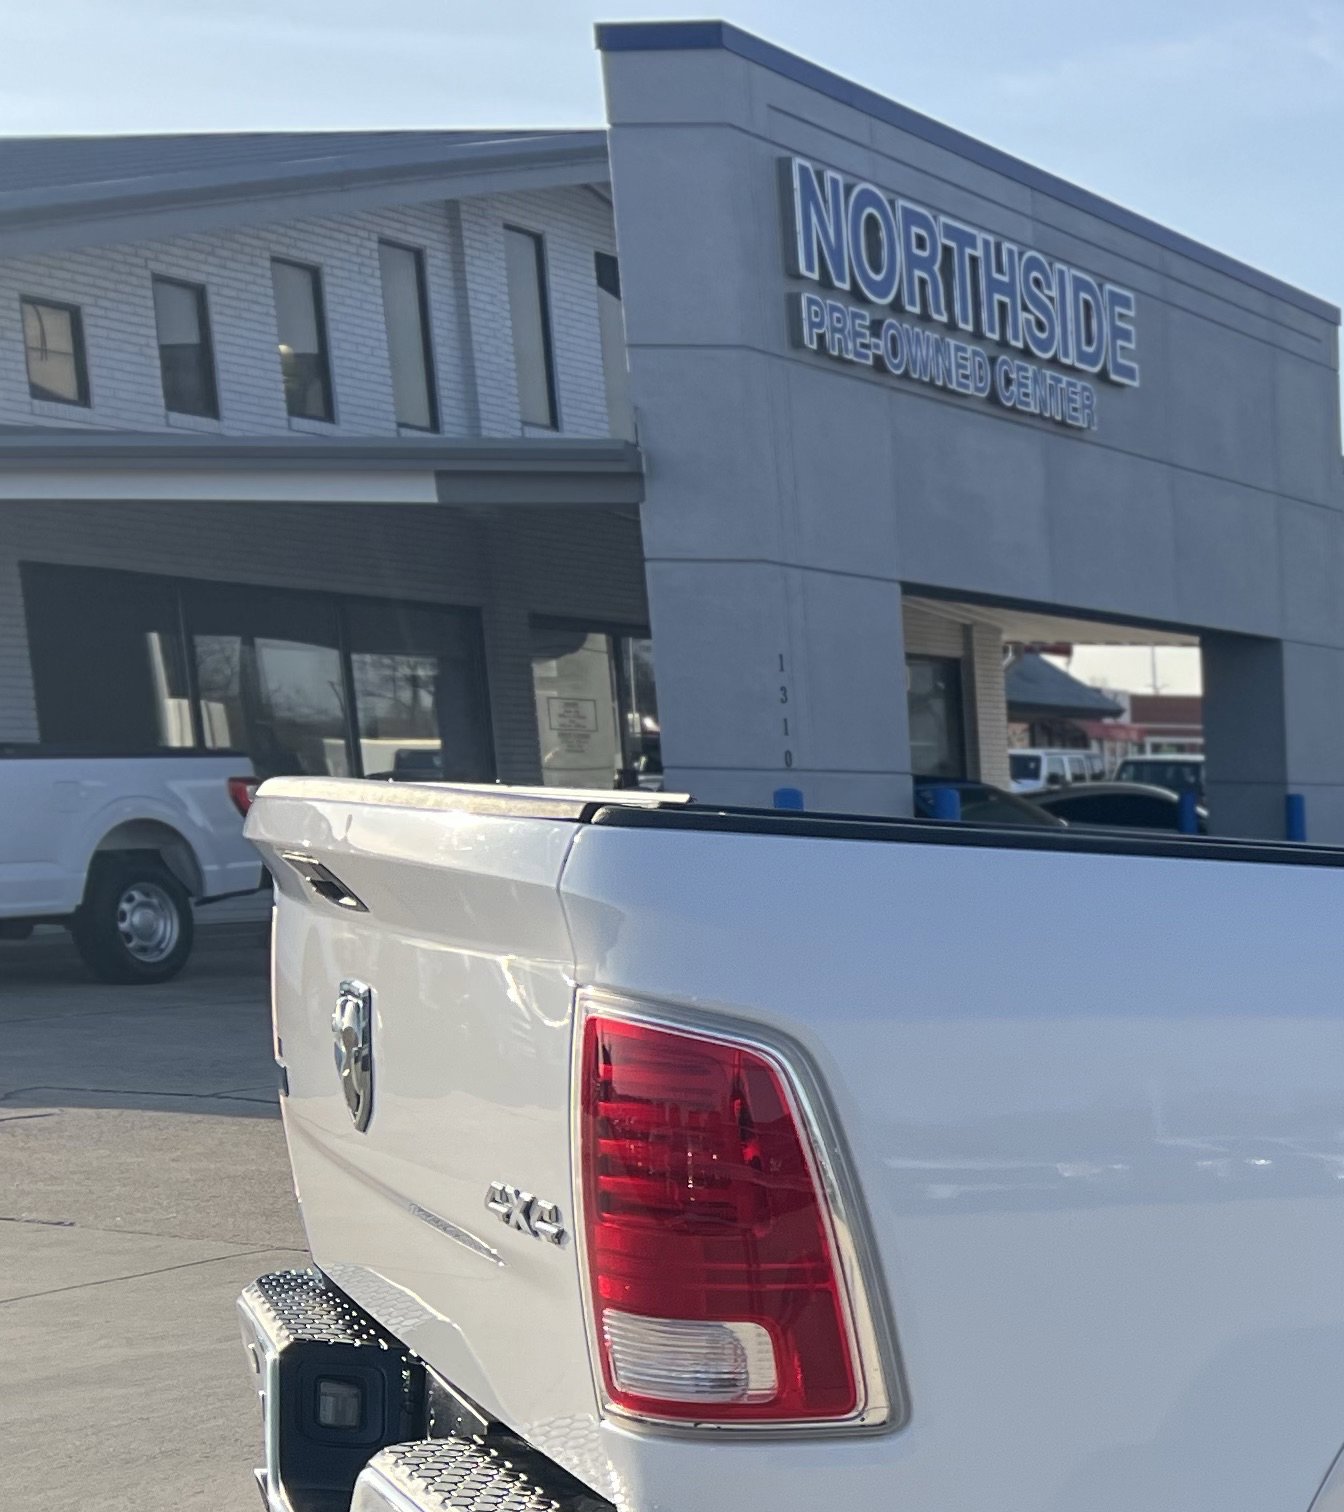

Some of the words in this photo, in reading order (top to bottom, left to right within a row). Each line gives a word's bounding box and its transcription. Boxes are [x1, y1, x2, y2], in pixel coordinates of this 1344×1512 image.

[790, 157, 1140, 386] NORTHSIDE
[801, 292, 990, 397] PRE-OWNED
[995, 356, 1098, 430] CENTER
